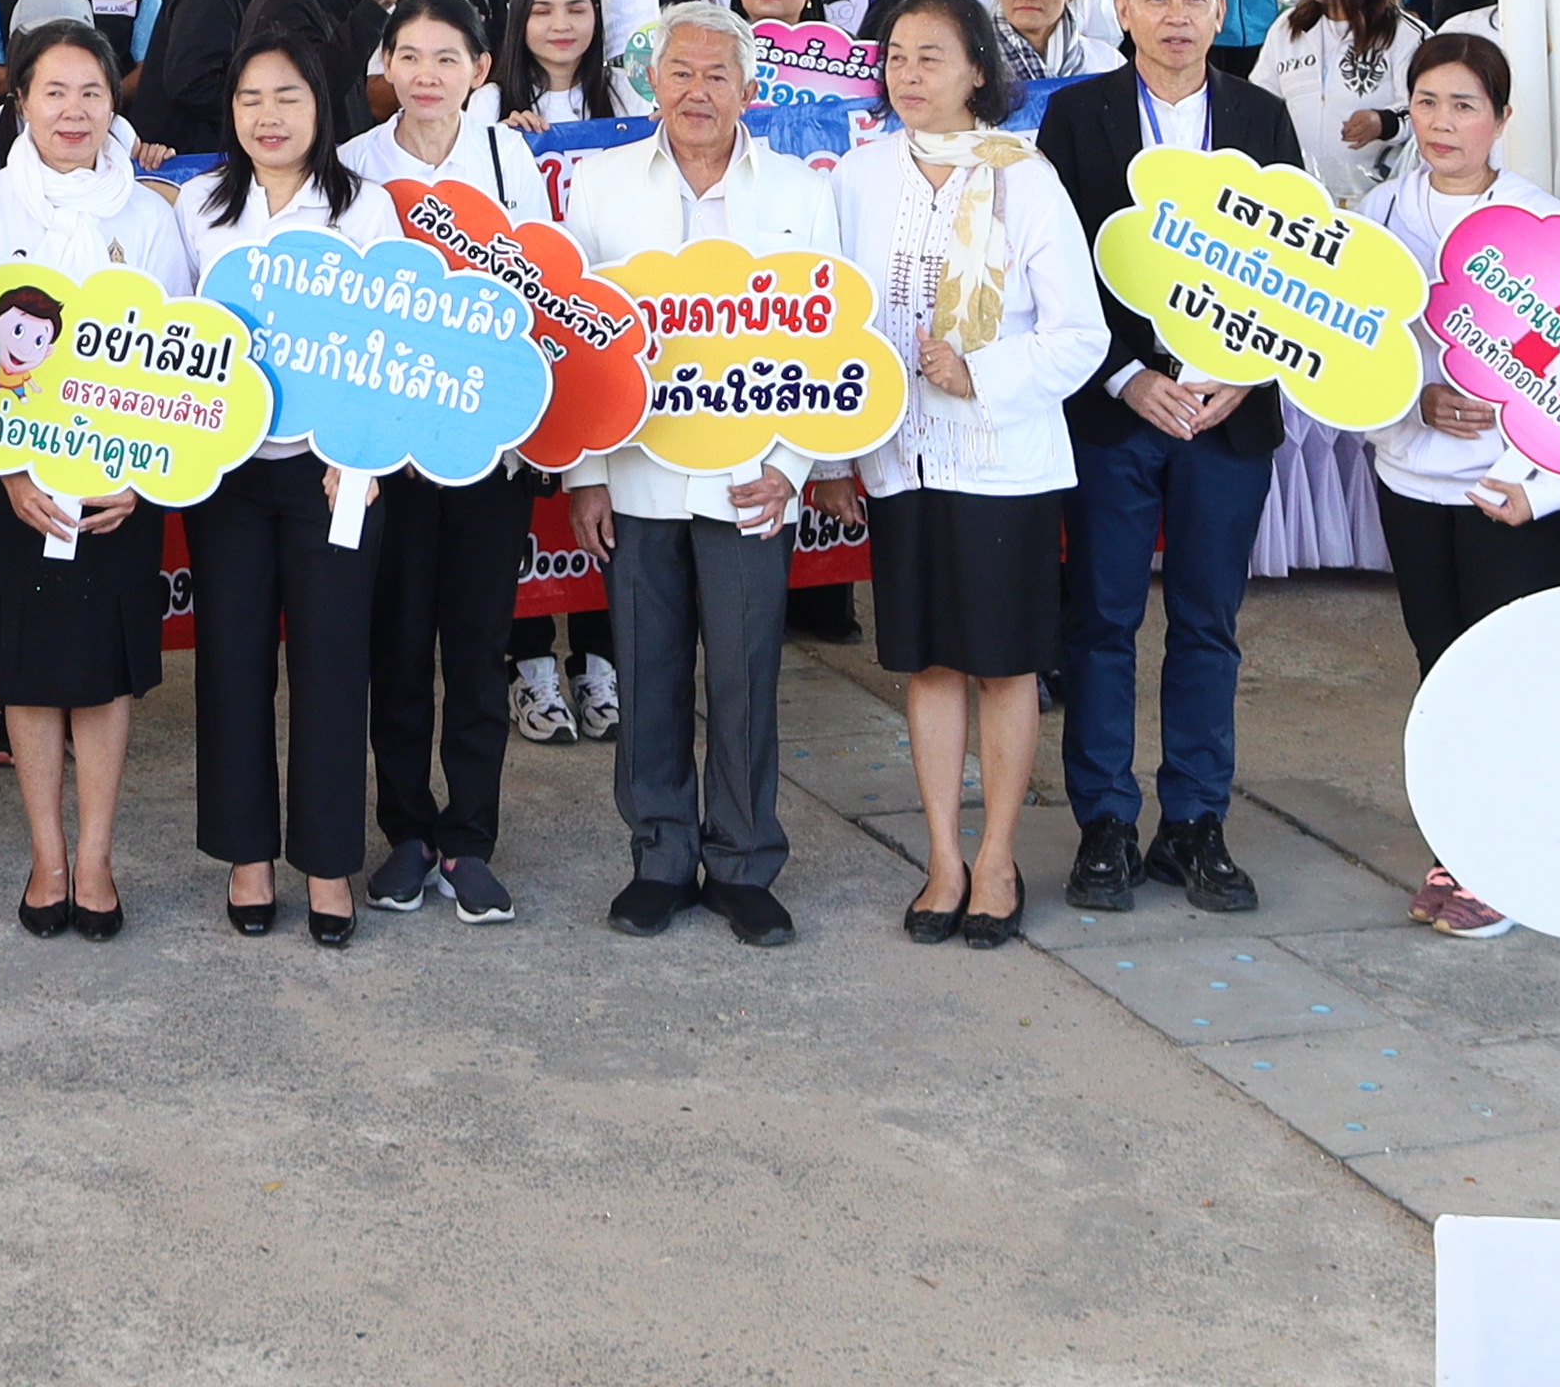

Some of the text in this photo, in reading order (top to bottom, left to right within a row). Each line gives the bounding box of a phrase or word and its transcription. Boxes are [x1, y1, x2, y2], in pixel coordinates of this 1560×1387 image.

[409, 196, 629, 351] เลือกตั้งคือหน้าที่
[1151, 201, 1386, 349] โปรดเลือกคนดี
[1217, 185, 1349, 268] เสาร์นี้
[247, 244, 517, 342] ทุกเสียงคือพลัง
[1168, 283, 1322, 380] เข้าสู่สภา
[75, 309, 232, 383] อย่าลืม!
[251, 315, 485, 414] ร่วมกันใช้สิทธิ
[61, 376, 225, 430] ตรวจสอบสิทธิ
